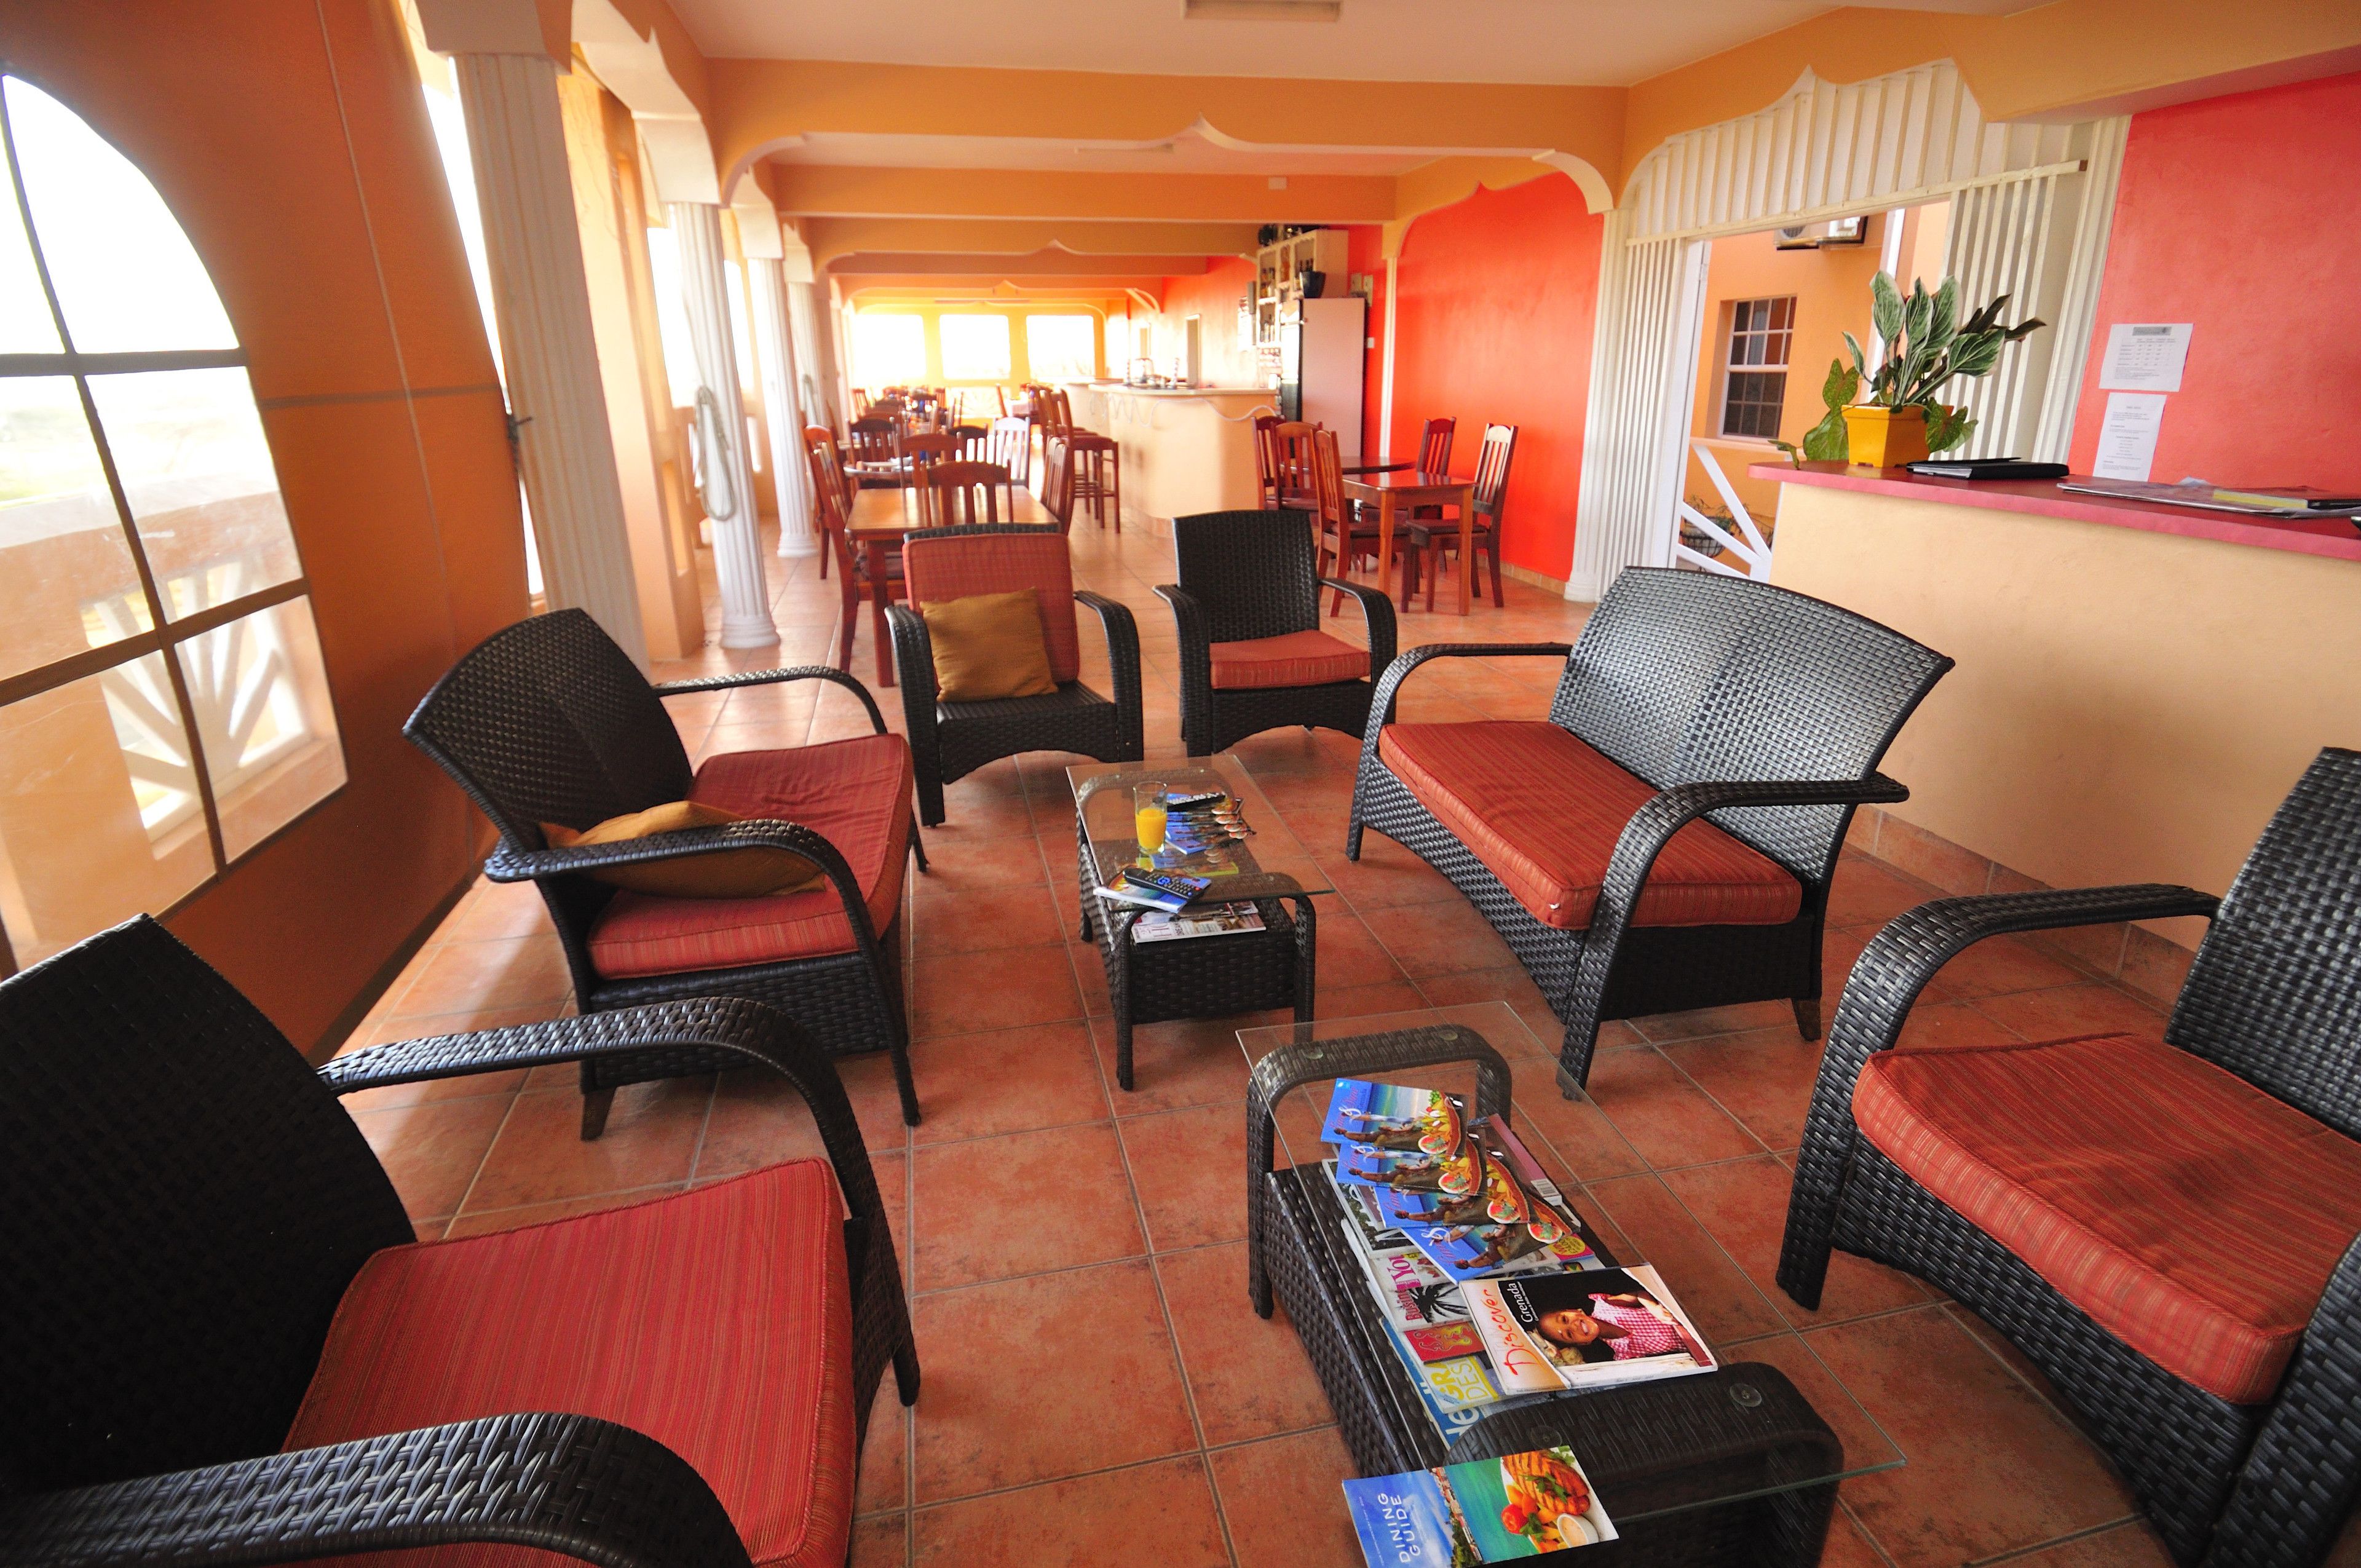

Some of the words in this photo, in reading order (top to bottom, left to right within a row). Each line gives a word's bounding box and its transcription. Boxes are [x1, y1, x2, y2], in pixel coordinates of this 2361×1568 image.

[1481, 1289, 1546, 1376] Discover
[1507, 1282, 1533, 1323] Grenada
[1378, 1493, 1411, 1562] DINING
[1390, 1495, 1422, 1556] GUIDE
